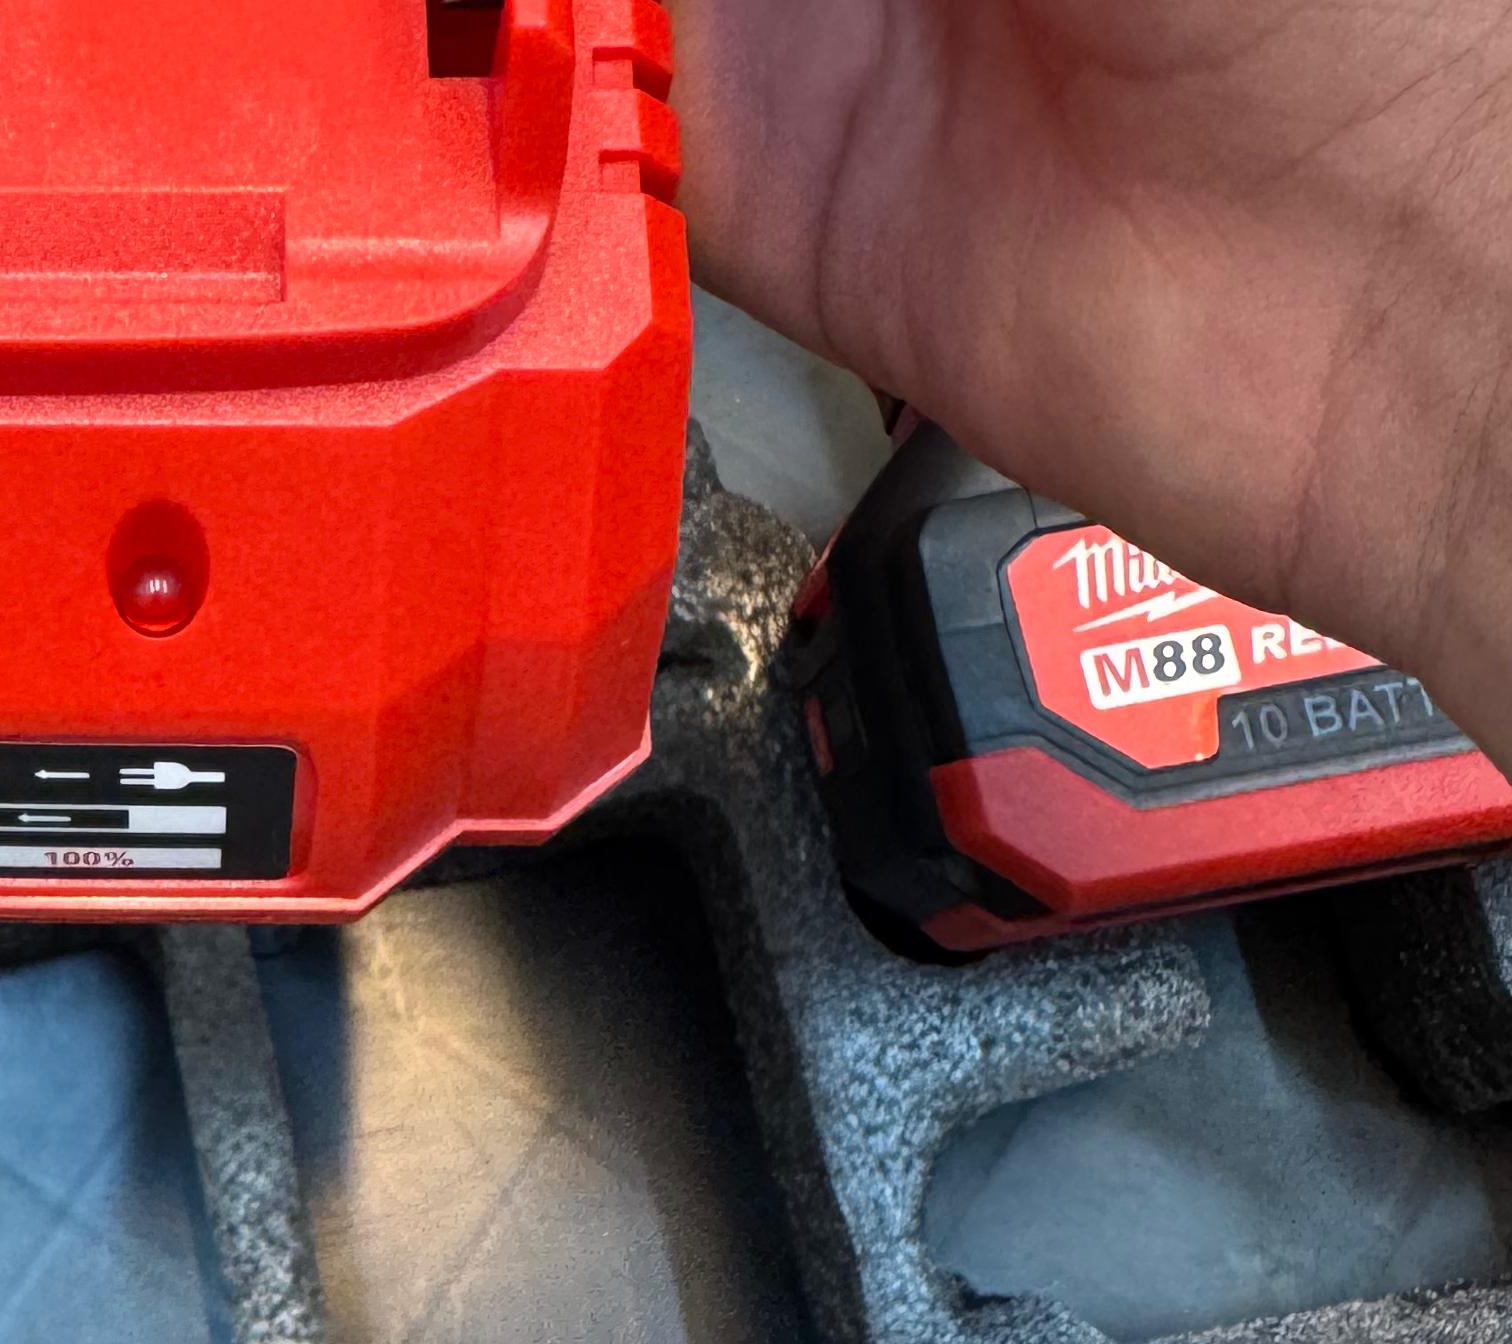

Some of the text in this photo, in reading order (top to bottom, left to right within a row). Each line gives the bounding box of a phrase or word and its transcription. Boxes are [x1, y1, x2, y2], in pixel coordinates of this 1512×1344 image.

[1094, 622, 1349, 697] M88 RE
[1231, 704, 1288, 751] 10
[43, 851, 135, 868] 100%
